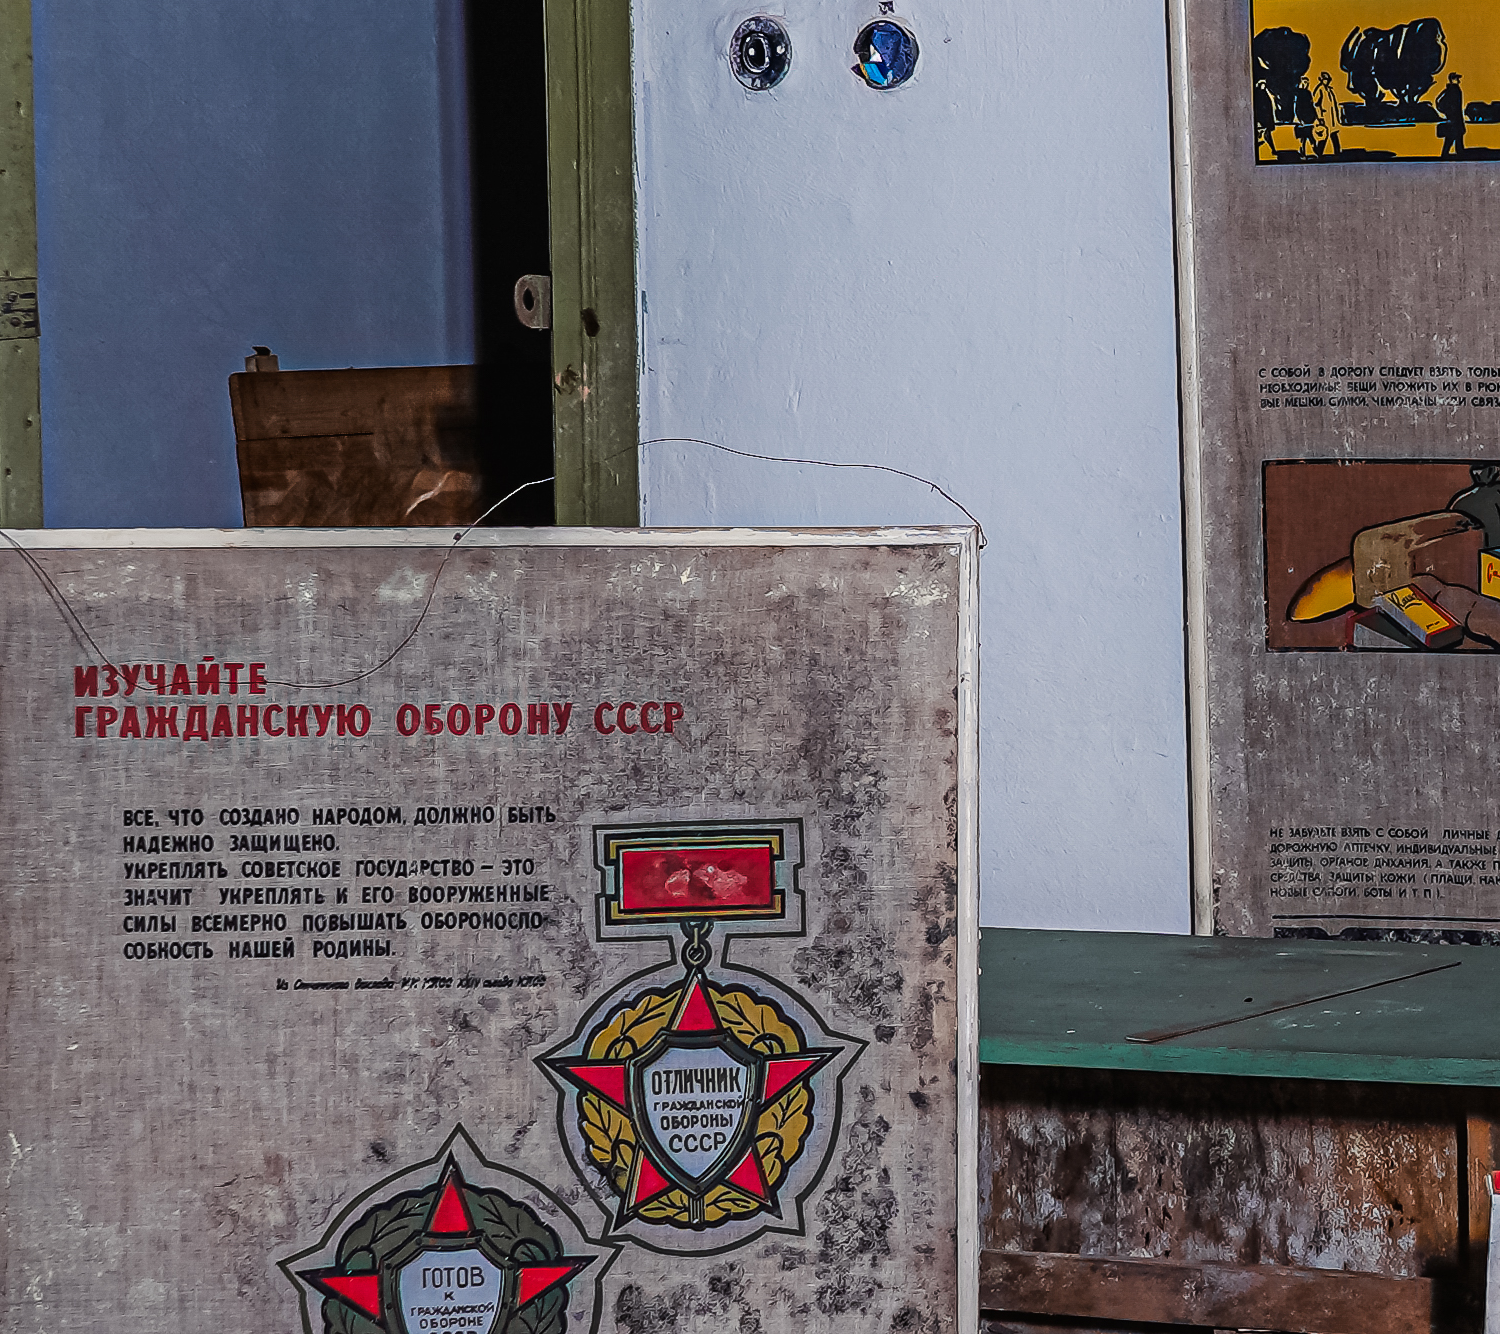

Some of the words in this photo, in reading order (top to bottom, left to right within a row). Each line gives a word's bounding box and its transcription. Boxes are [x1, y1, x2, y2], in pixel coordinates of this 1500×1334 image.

[75, 656, 266, 697] ИЗУЧАЙТЕ
[75, 703, 371, 741] ГРАЖДАНСКУЮ
[397, 702, 572, 736] ОБОРОНУ
[593, 701, 684, 734] СССР
[168, 809, 203, 826] ЧТО
[220, 808, 299, 827] СОЗДАНО
[313, 807, 406, 826] НАРОДОМ,
[414, 806, 494, 826] ДОЛЖНО
[508, 806, 556, 824] БЫТЬ
[123, 835, 214, 854] НАДЕЖНО
[229, 833, 340, 853] ЗАЩИЩЕНО.
[124, 861, 228, 880] УКРЕПЛЯТЬ
[241, 861, 340, 878] СОВЕТСКОЕ
[356, 859, 474, 878] ГОСУДАРСТВО
[502, 859, 534, 876] ЭТО
[123, 889, 192, 906] ЗНАЧИТ
[220, 887, 325, 905] УКРЕПЛЯТЬ
[337, 887, 347, 904] И
[362, 887, 394, 904] ЕГО
[409, 885, 549, 902] ВООРУЖЕННЫЕ
[123, 915, 176, 934] СИЛЫ
[192, 914, 286, 932] ВСЕМЕРНО
[303, 913, 406, 932] ПОВЫШАТЬ
[124, 943, 212, 959] СОБНОСТЬ
[229, 938, 294, 958] НАШЕЙ
[313, 940, 396, 959] РОДИНЫ.
[652, 1067, 741, 1095] ОТЛИЧНИК
[654, 1095, 743, 1111] ГРАЖДАНСКОЙ
[660, 1114, 733, 1130] ОБОРОНЫ
[669, 1132, 726, 1153] СССР
[423, 1266, 484, 1288] ГОТОВ
[444, 1291, 455, 1301] К
[411, 1302, 494, 1316] ГРАЖДАНСКОЙ
[420, 1317, 483, 1329] ОБОРОНЕ
